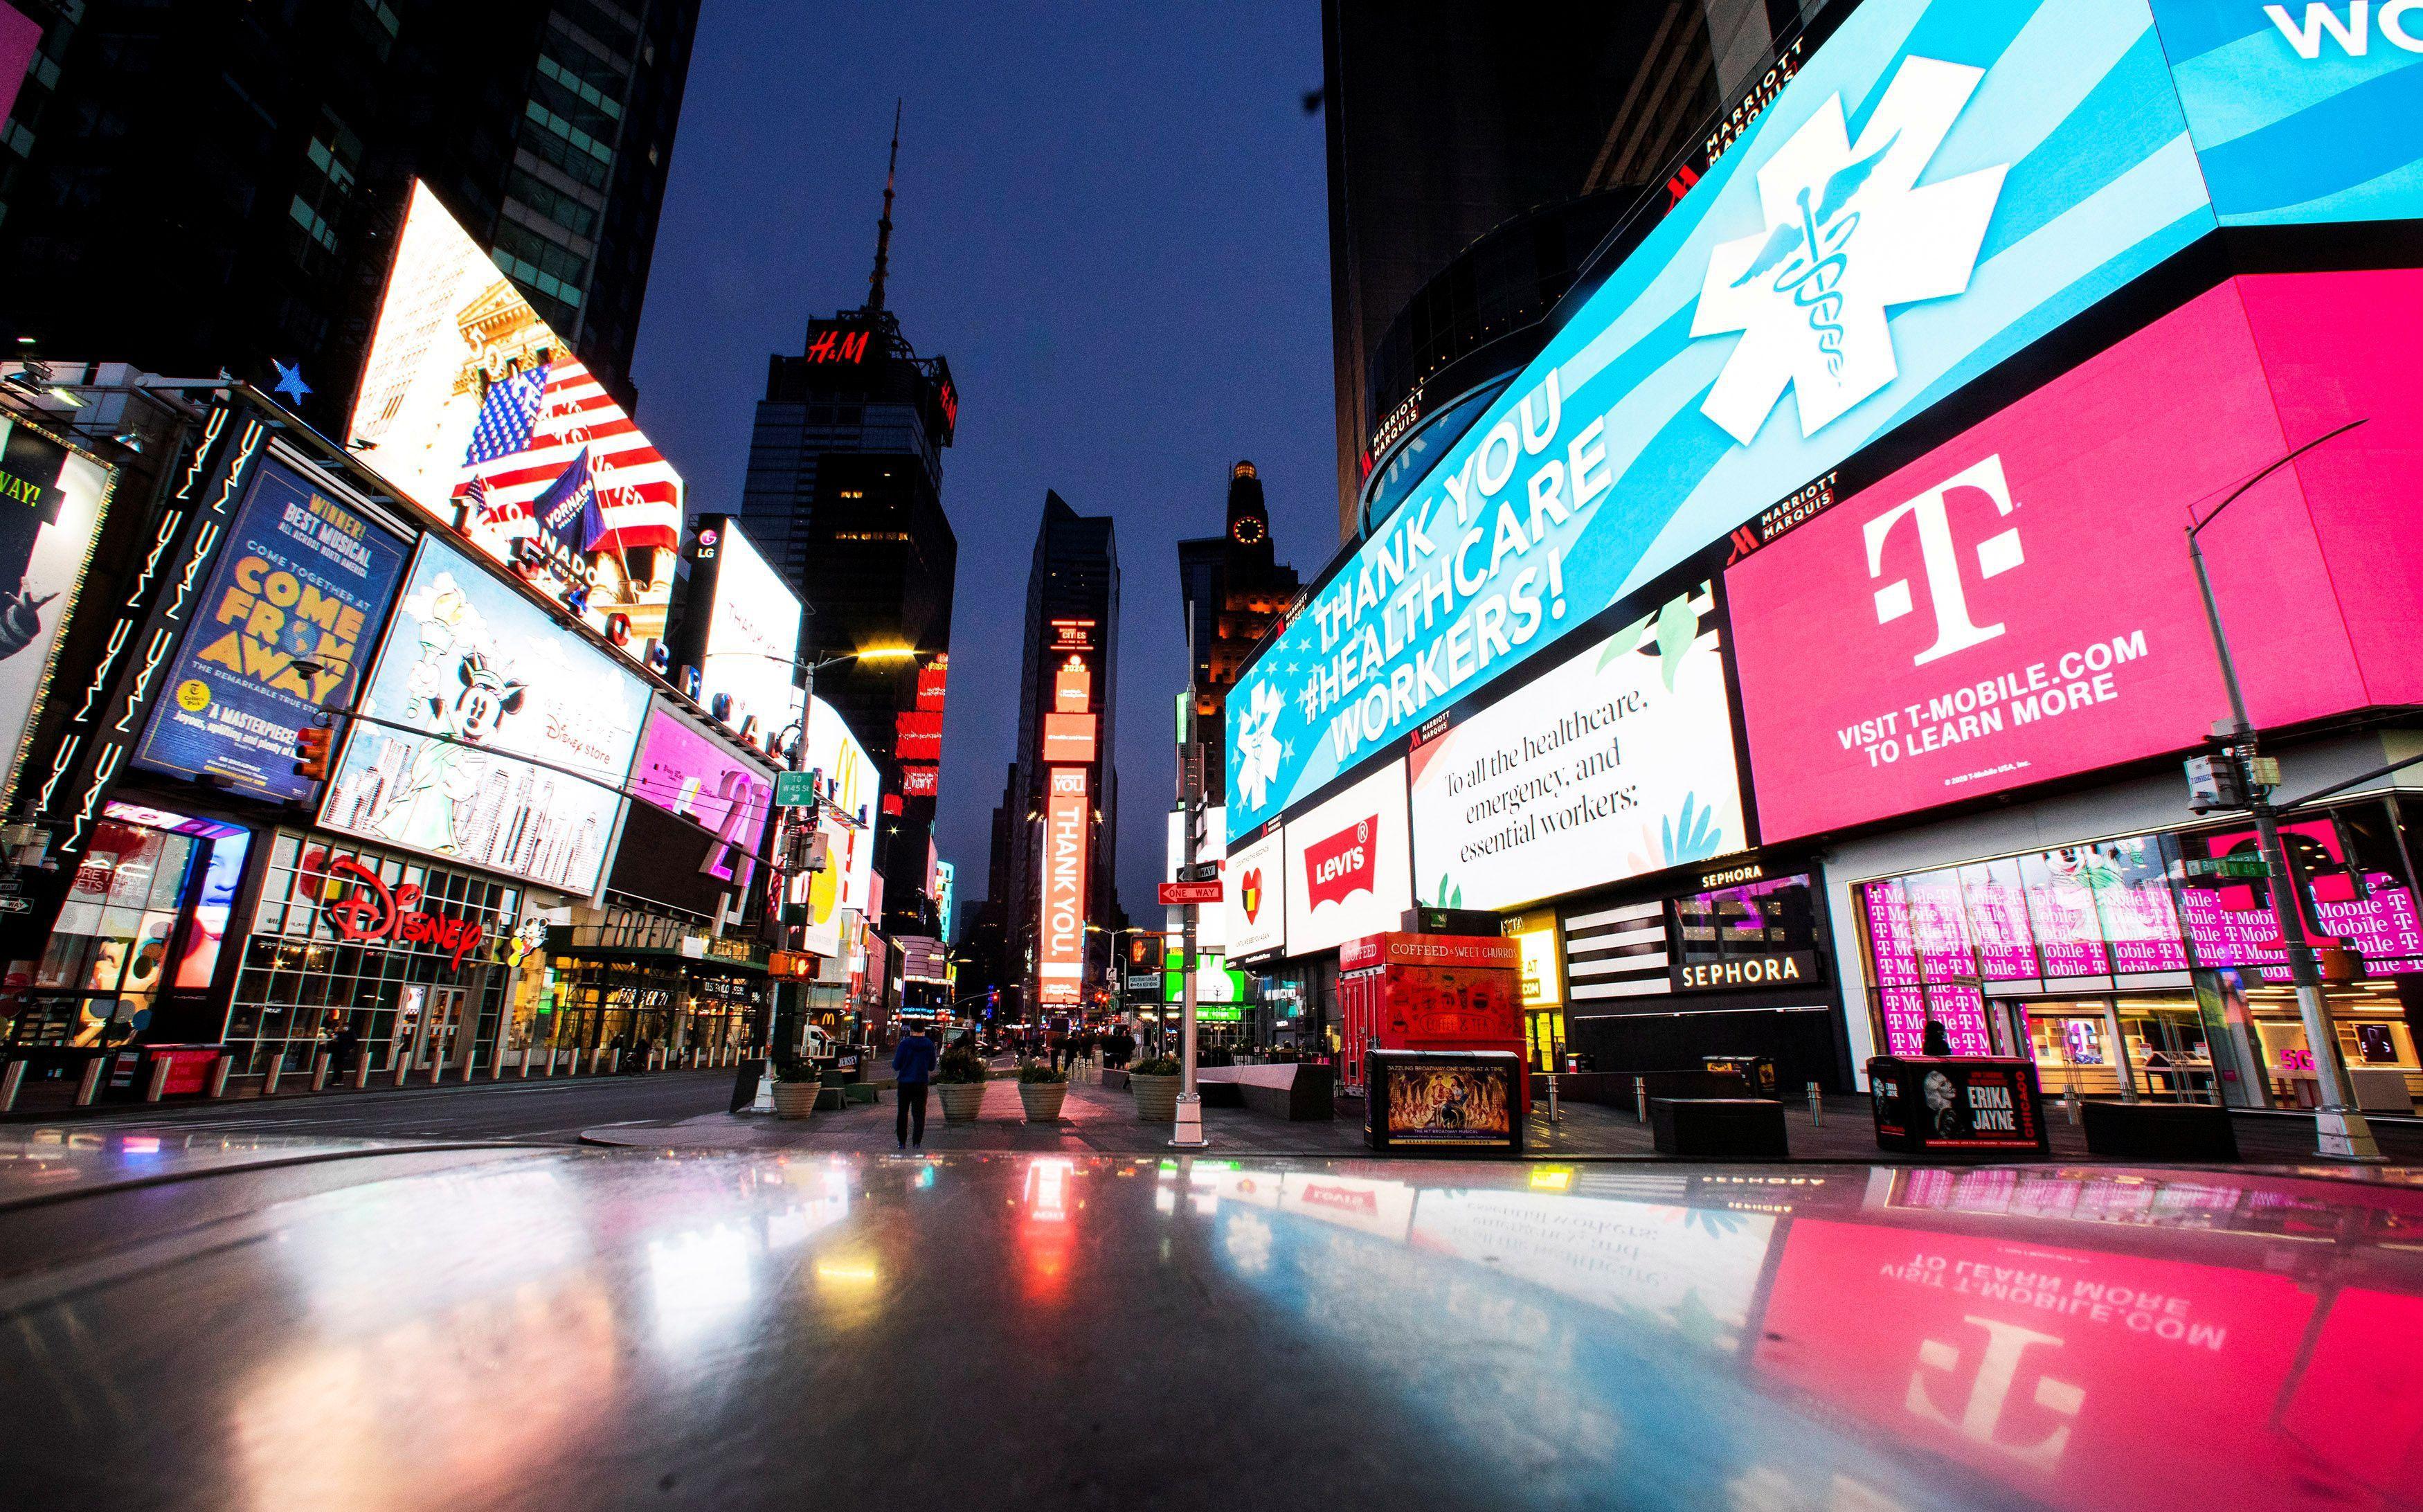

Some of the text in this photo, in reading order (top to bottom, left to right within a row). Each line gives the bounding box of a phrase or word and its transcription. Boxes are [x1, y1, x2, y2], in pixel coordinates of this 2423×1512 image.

[1706, 37, 1804, 154] MARRIOTT
[807, 330, 870, 364] H&M
[1373, 389, 1423, 444] MARRIOTT
[1373, 404, 1418, 460] MARQUIS
[308, 492, 367, 541] WINNER!
[544, 479, 593, 527] VORNADO
[1315, 367, 1565, 654] THANK YOU
[1762, 471, 1838, 526] MARRIOTT
[1763, 492, 1832, 541] MARQUIS
[278, 521, 294, 537] ALL
[292, 530, 321, 552] ACROSS
[283, 502, 372, 569] BEST MUSICAL
[697, 548, 714, 558] LG
[246, 540, 372, 612] COME TOGETHER AT
[1304, 415, 1614, 726] #HEALTHCARE
[235, 556, 366, 645] COME
[728, 602, 764, 643] THANK
[1286, 593, 1308, 620] MARRIOTT
[196, 629, 344, 705] AWAY
[1330, 546, 1567, 763] WORKERS!
[192, 660, 214, 674] THE
[215, 667, 277, 699] REMARKABLE
[279, 693, 301, 709] TRUE
[1837, 629, 2148, 750] VISIT T-MOBILE.COM
[242, 732, 258, 745] and
[1421, 710, 1450, 733] MARRIOTT
[1422, 721, 1448, 741] MARQUIS
[1864, 672, 2118, 767] TO LEARN MORE
[585, 744, 611, 765] store
[1445, 687, 1648, 797] To all the healthcare,
[1054, 779, 1085, 792] YOU
[1466, 737, 1621, 825] emergency, and
[1951, 775, 1968, 784] 2020
[1967, 768, 1998, 780] T-Mobile
[699, 770, 772, 888] 21
[1460, 783, 1638, 863] essential workers:
[1056, 807, 1080, 890] THANK
[1169, 888, 1215, 898] ONE WAY
[1200, 866, 1214, 877] WAY
[1702, 865, 1763, 888] SEPHORA
[8, 901, 24, 909] WAY
[1051, 896, 1077, 957] YOU.
[2314, 900, 2383, 919] Mobile
[2318, 916, 2389, 937] Mobile
[1345, 944, 1377, 962] COFFEED
[1391, 943, 1448, 957] COFFEED
[1454, 946, 1480, 958] SWEET
[1482, 948, 1517, 959] CHURROS
[1682, 957, 1800, 988] SEPHORA
[2280, 1049, 2315, 1071] 5G
[1967, 1086, 2013, 1109] ERIKA
[1972, 1110, 2016, 1131] JAYNE
